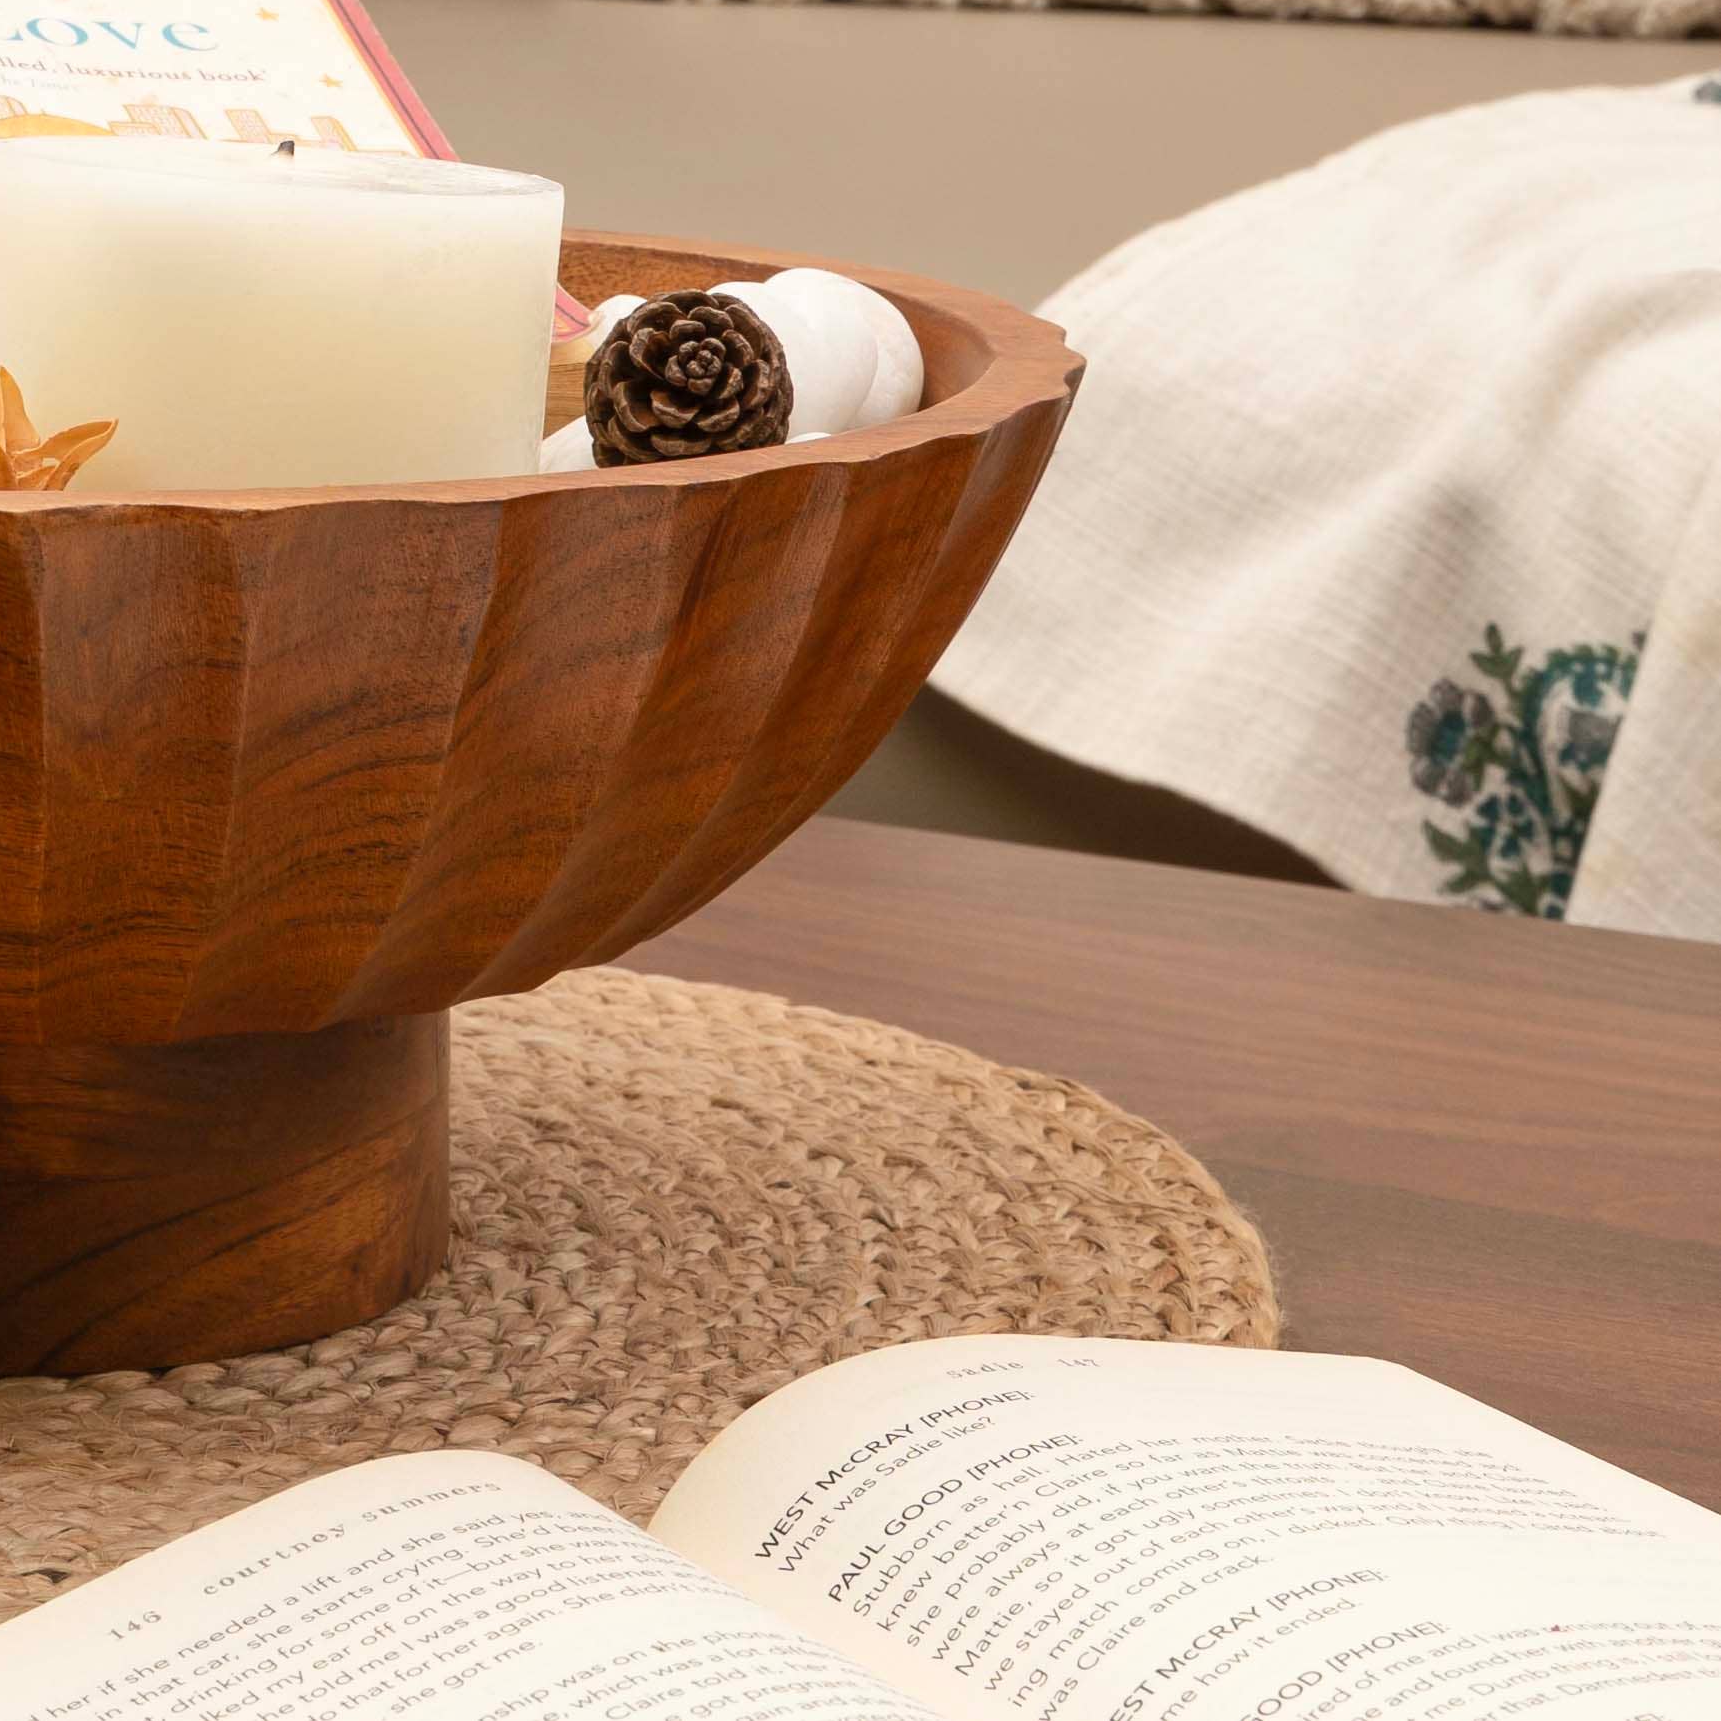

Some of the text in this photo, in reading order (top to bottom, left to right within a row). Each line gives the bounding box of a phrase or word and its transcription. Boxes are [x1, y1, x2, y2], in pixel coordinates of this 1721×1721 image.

[65, 58, 191, 81] luxurious
[755, 1492, 813, 1557] WEST
[815, 1424, 913, 1490] McCRAY
[778, 1417, 995, 1571] What was Sadie like?
[828, 1544, 886, 1602] PAUL
[884, 1480, 962, 1535] GOOD
[854, 1439, 1180, 1616] Stubborn as hell. Hated her
[877, 1571, 931, 1631] knew
[932, 1501, 1030, 1564] better'n
[1035, 1470, 1108, 1496] Claire
[1115, 1462, 1144, 1470] so
[907, 1465, 1237, 1647] she probably did, if you want
[46, 1695, 89, 1718] her
[101, 1680, 116, 1695] if
[125, 1660, 170, 1683] she
[178, 1604, 276, 1658] needed
[284, 1597, 299, 1605] a
[301, 1576, 341, 1594] lift
[347, 1548, 395, 1575] and
[401, 1533, 446, 1551] she
[453, 1515, 505, 1533] said
[111, 1484, 501, 1639] 146 courtney summers
[130, 1678, 185, 1705] that
[193, 1653, 239, 1676] car,
[247, 1625, 292, 1649] she
[301, 1586, 373, 1622] starts
[383, 1549, 469, 1583] crying.
[474, 1525, 551, 1547] She'd
[171, 1659, 277, 1713] drinking
[277, 1638, 313, 1659] for
[321, 1604, 390, 1639] some
[397, 1584, 421, 1602] of
[520, 1544, 565, 1557] she
[266, 1556, 622, 1693] my ear off on the way to her
[932, 1606, 980, 1659] were
[986, 1542, 1060, 1597] always
[1067, 1523, 1093, 1538] at
[1100, 1498, 1158, 1521] each
[955, 1601, 1031, 1676] Mattie,
[1035, 1572, 1063, 1592] so
[1069, 1555, 1089, 1566] it
[1095, 1530, 1138, 1554] got
[1143, 1509, 1195, 1528] ugly
[985, 1658, 1014, 1690] we
[1016, 1584, 1090, 1651] stayed
[1094, 1558, 1135, 1583] out
[1140, 1540, 1164, 1557] of
[1170, 1522, 1229, 1543] each
[1008, 1669, 1048, 1707] ing
[1049, 1601, 1119, 1659] match
[1127, 1549, 1219, 1595] coming
[1224, 1537, 1265, 1548] on,
[1077, 1617, 1145, 1670] Claire
[1150, 1581, 1197, 1613] and
[1201, 1556, 1273, 1583] crack.
[298, 1671, 354, 1703] told
[359, 1652, 399, 1674] me
[417, 1619, 469, 1643] was
[474, 1610, 490, 1619] a
[496, 1580, 567, 1612] good
[340, 1681, 394, 1709] that
[394, 1661, 431, 1681] for
[433, 1639, 477, 1662] her
[484, 1610, 561, 1640] again.
[563, 1594, 615, 1609] She
[391, 1642, 542, 1713] she got me.
[555, 1665, 606, 1688] was
[613, 1651, 647, 1665] on
[570, 1675, 647, 1708] which
[691, 1668, 747, 1688] told
[1110, 1680, 1154, 1721] EST
[1155, 1607, 1260, 1679] McCRAY
[1193, 1649, 1249, 1686] how
[1253, 1636, 1273, 1649] it
[1276, 1598, 1362, 1635] ended.
